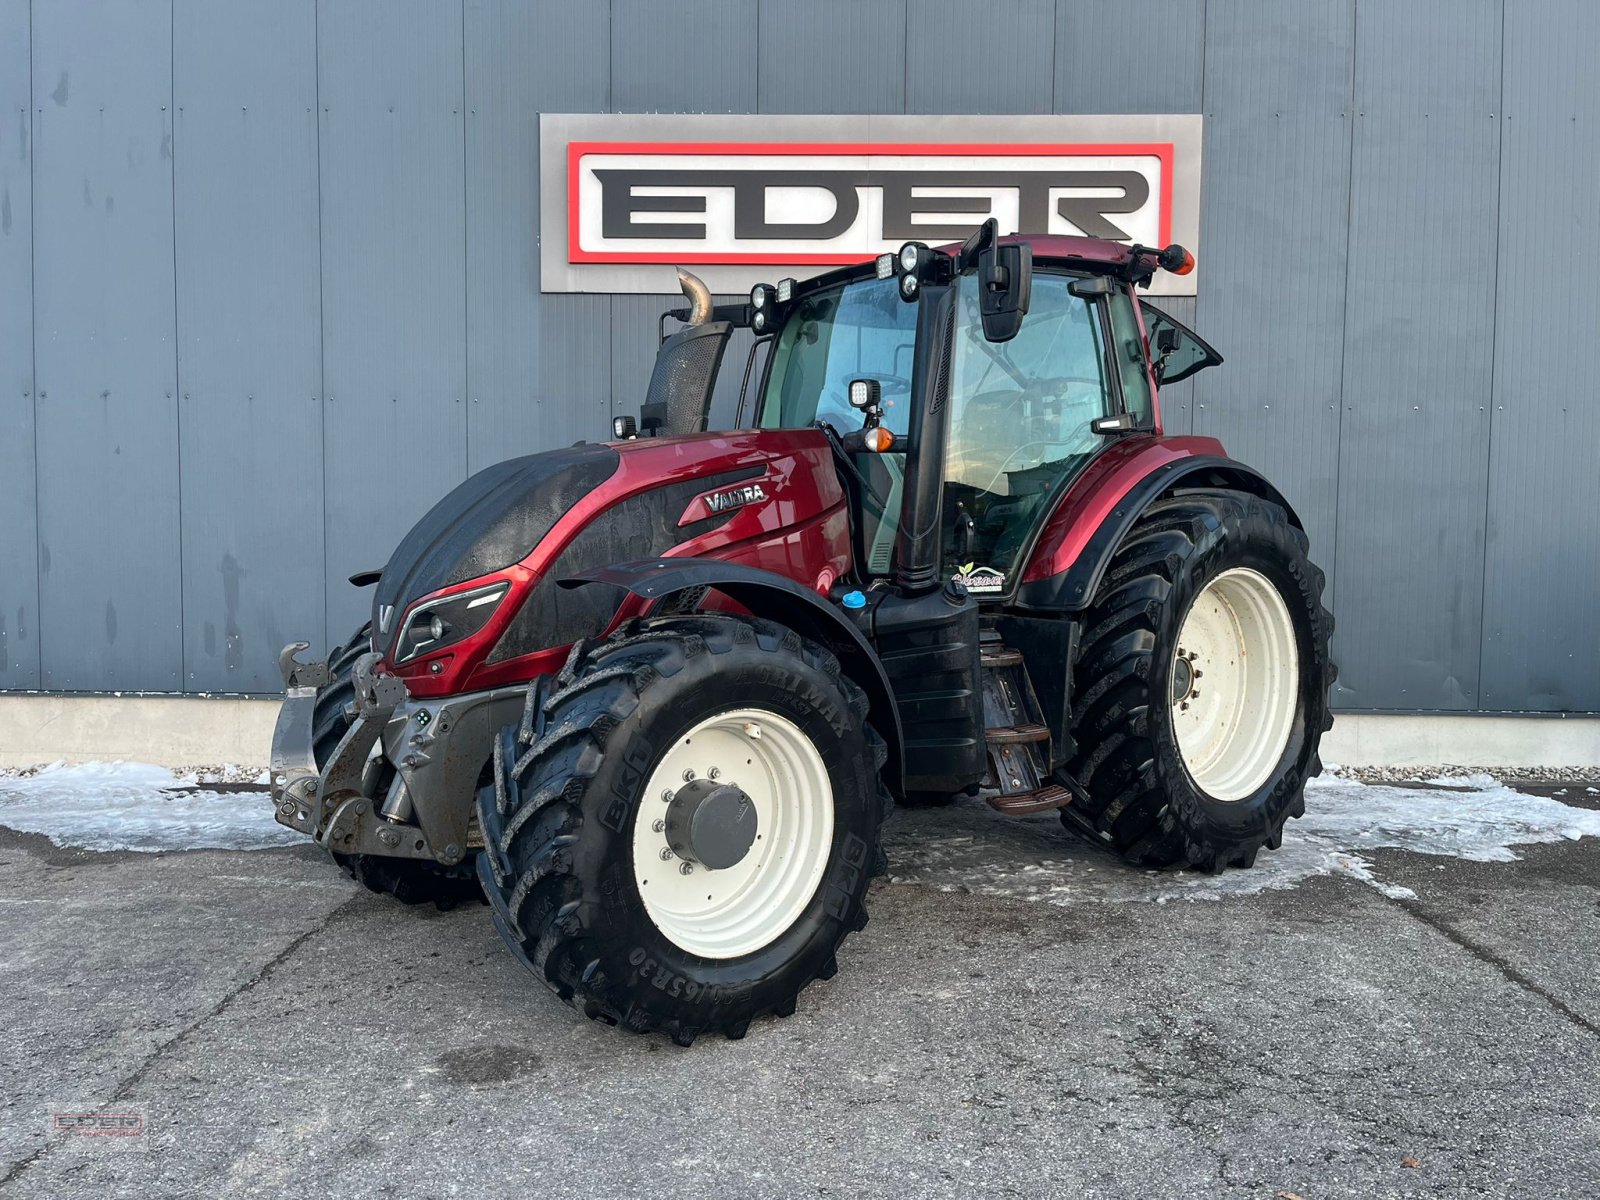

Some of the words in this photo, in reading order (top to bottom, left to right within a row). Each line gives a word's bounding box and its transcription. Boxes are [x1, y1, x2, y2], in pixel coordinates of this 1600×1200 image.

[591, 169, 1150, 240] EDER
[704, 485, 764, 512] VALTRA
[599, 731, 653, 833] BKT
[825, 832, 868, 921] BKT
